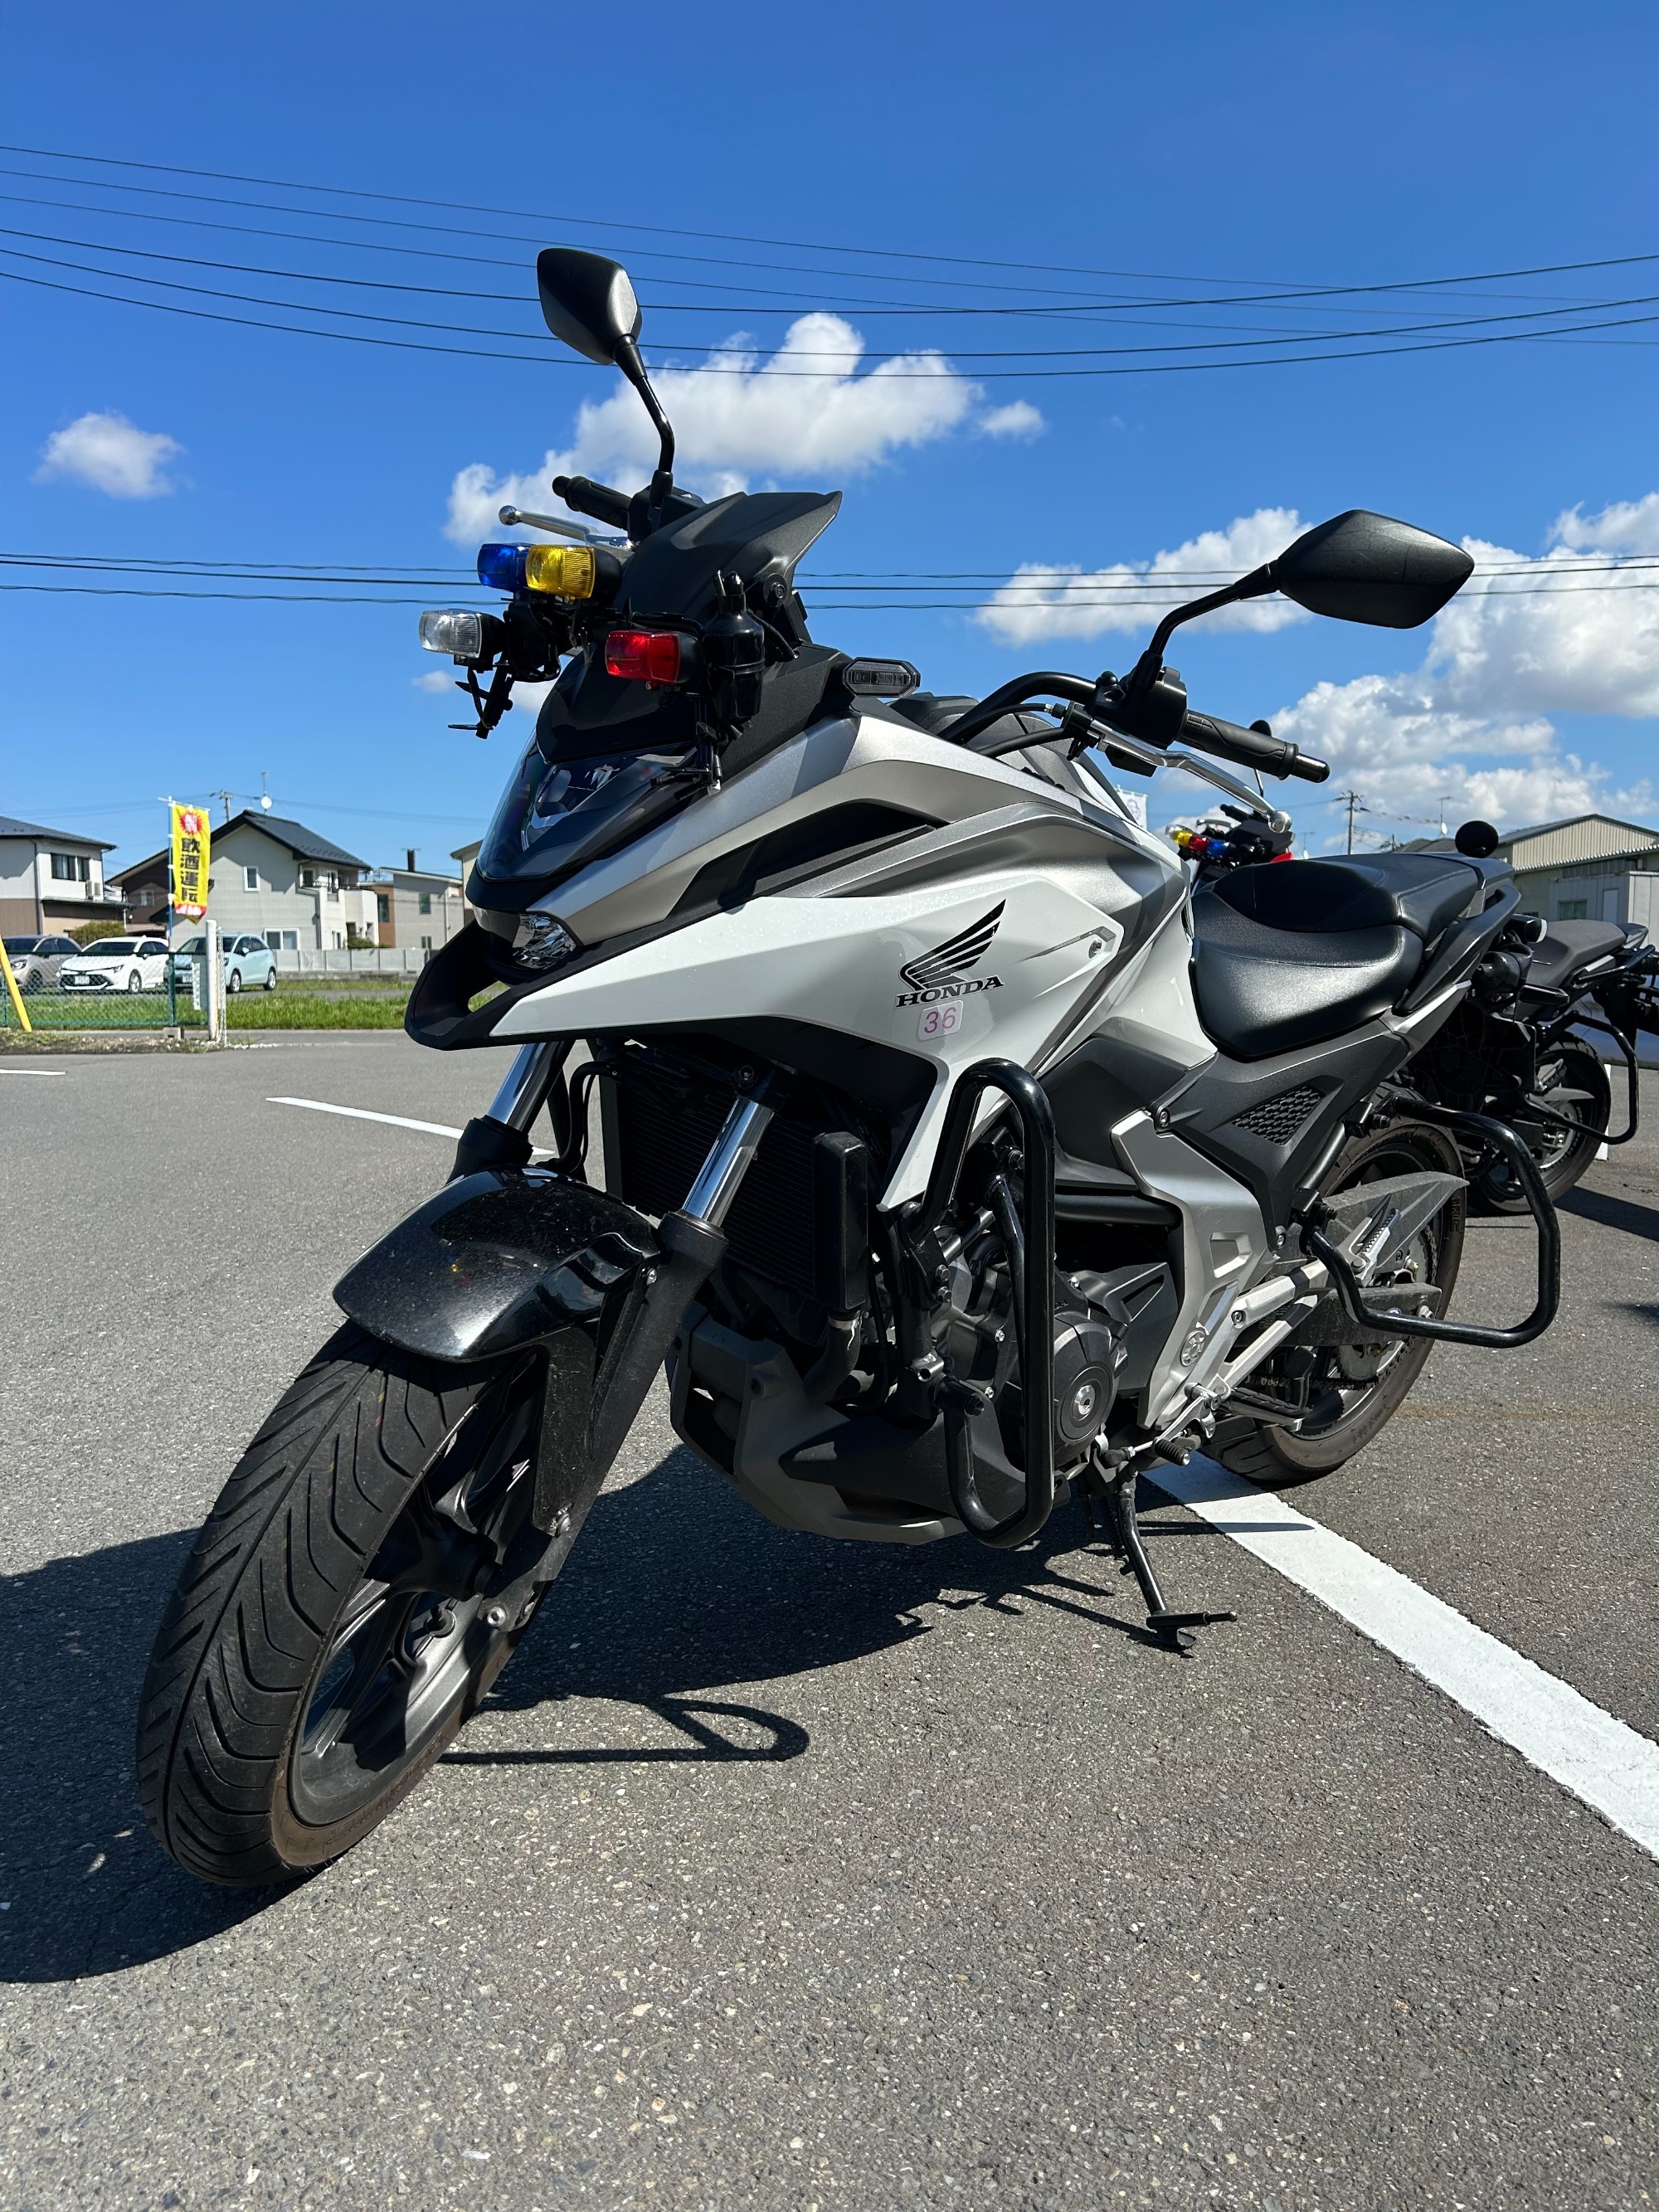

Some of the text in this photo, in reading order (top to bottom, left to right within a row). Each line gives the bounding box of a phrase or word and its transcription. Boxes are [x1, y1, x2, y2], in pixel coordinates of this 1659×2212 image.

[180, 837, 200, 902] 飲酒運転
[896, 975, 1005, 1008] HONDA
[923, 1008, 957, 1033] 36
